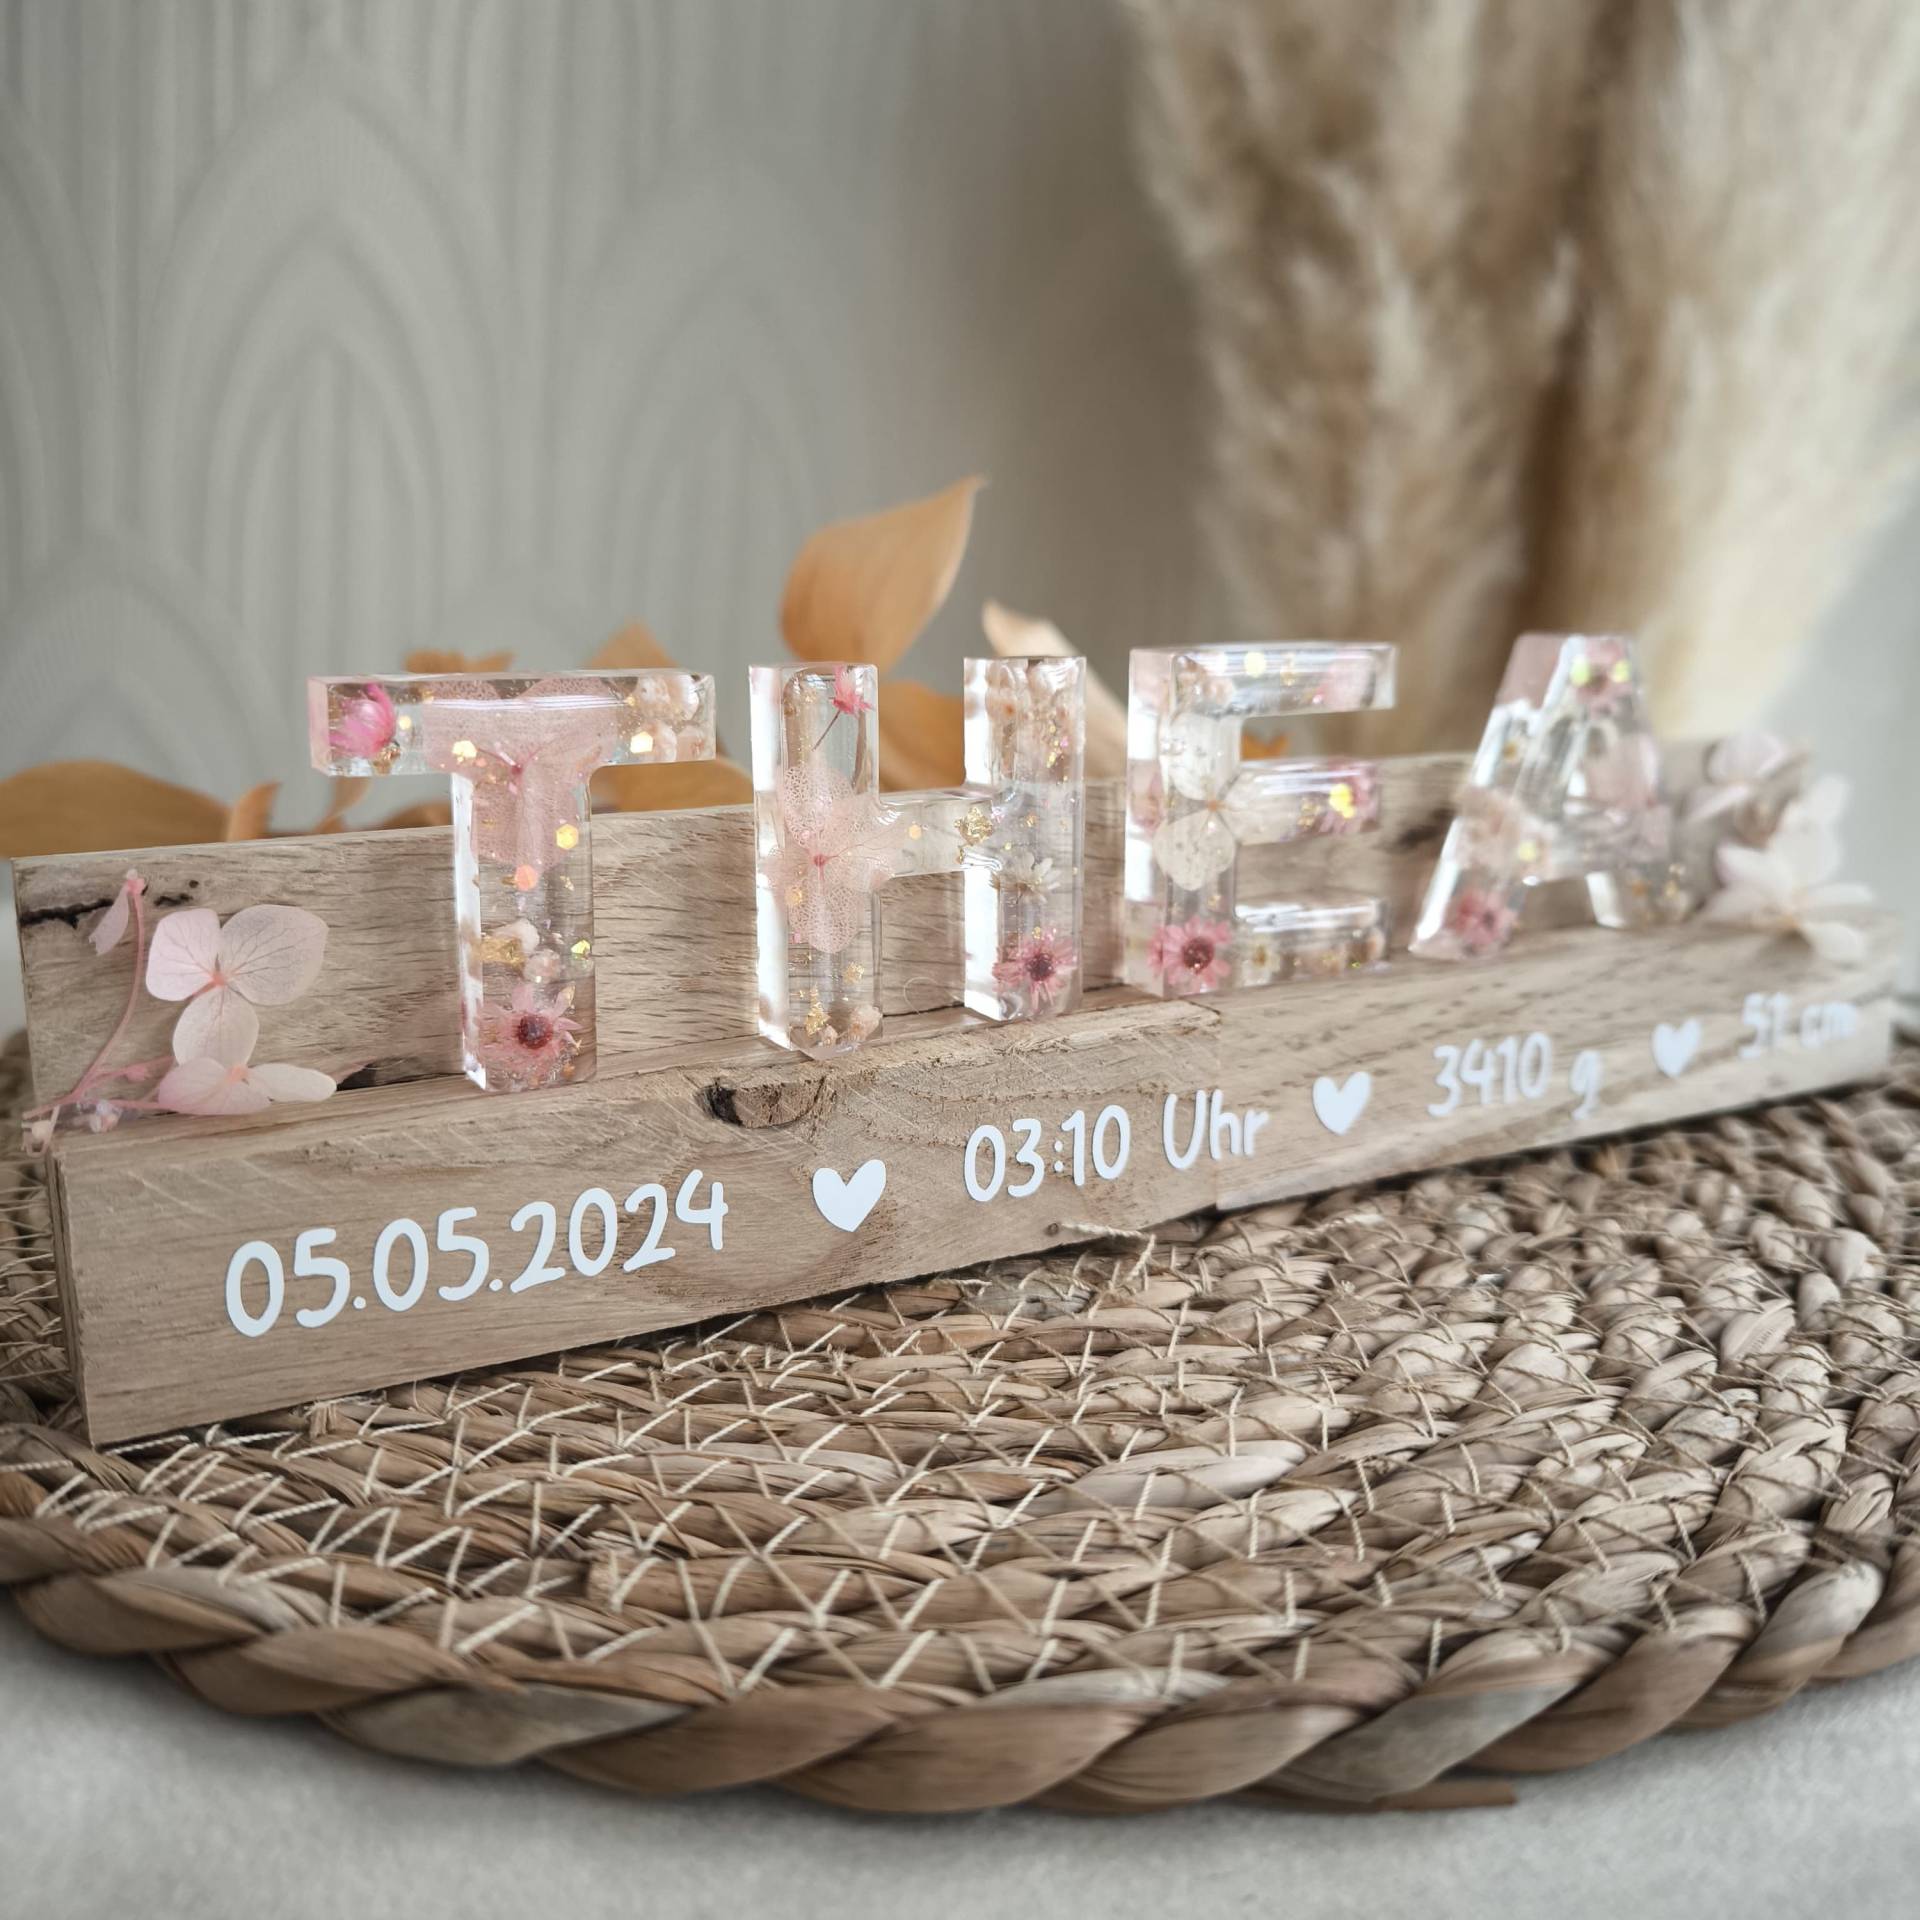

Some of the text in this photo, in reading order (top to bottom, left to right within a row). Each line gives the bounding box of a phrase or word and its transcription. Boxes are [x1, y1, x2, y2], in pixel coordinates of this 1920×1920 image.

[308, 633, 1692, 1095] THEA
[226, 992, 1858, 1337] 05.05.2024 03:10 Uhr 3410 g 51 cm
